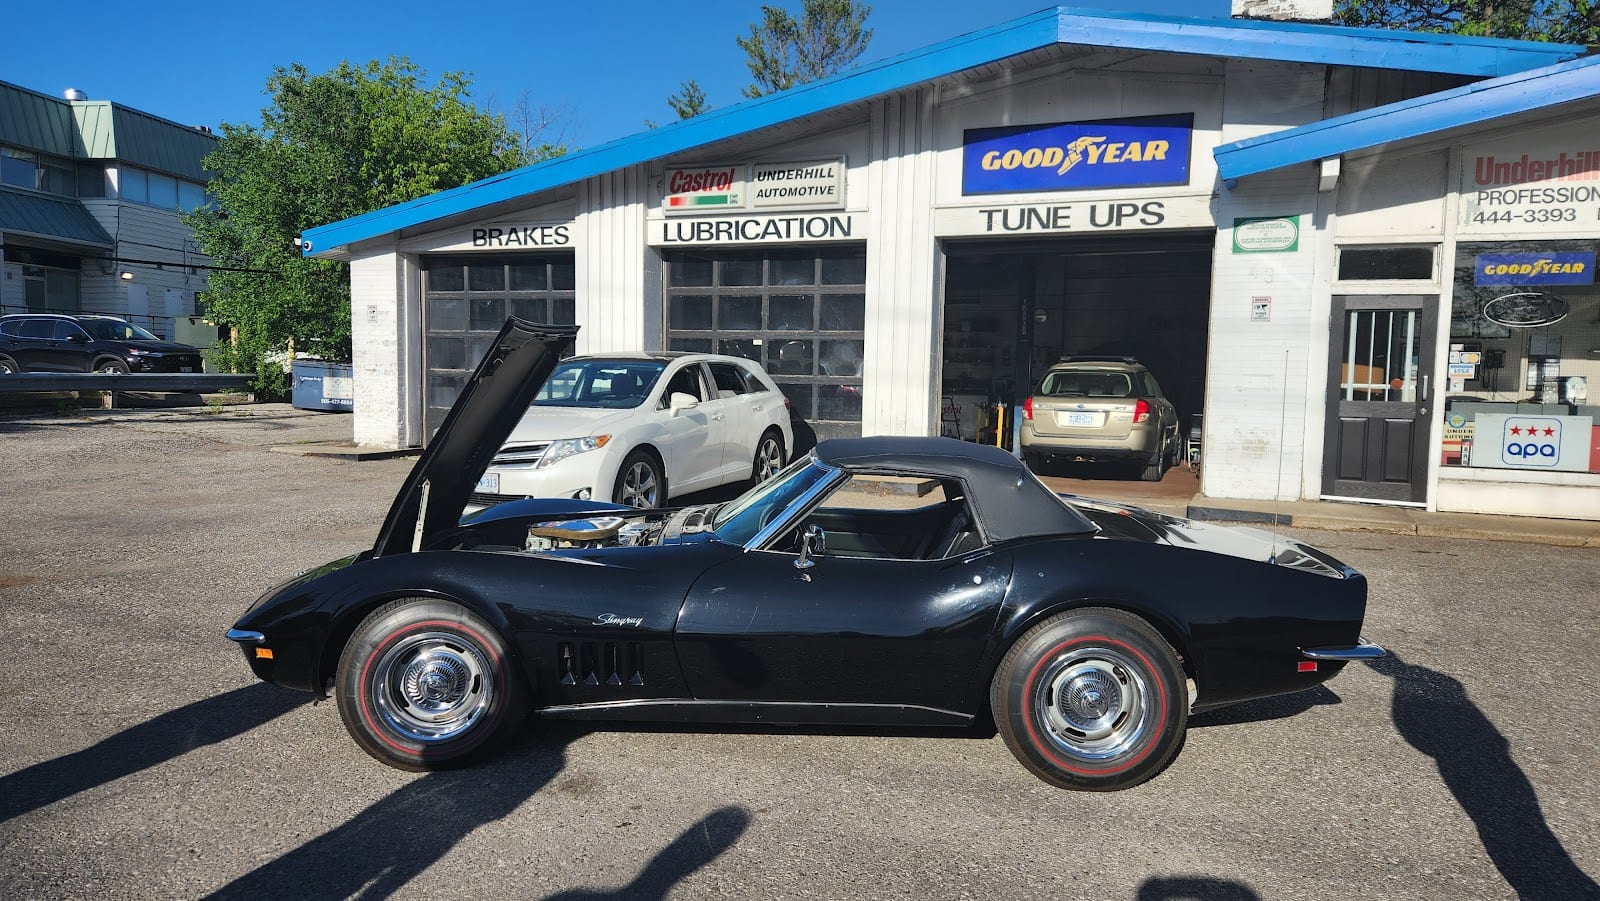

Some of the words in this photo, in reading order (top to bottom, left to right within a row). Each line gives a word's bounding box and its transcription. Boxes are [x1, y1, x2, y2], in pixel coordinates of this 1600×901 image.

[981, 139, 1169, 171] GOODYEAR
[757, 168, 834, 182] UNDERHILL
[1474, 151, 1600, 186] Underhill
[669, 168, 735, 194] Castrol
[756, 186, 835, 198] AUTOMOTIVE
[979, 206, 1071, 232] TUNE
[1089, 202, 1165, 226] UPS
[1473, 208, 1576, 225] 444-3393
[472, 226, 570, 247] BRAKES
[663, 216, 852, 242] LUBRICATION
[1484, 261, 1585, 276] GOODYEAR
[1507, 442, 1555, 458] apa
[592, 612, 643, 627] Stingray
